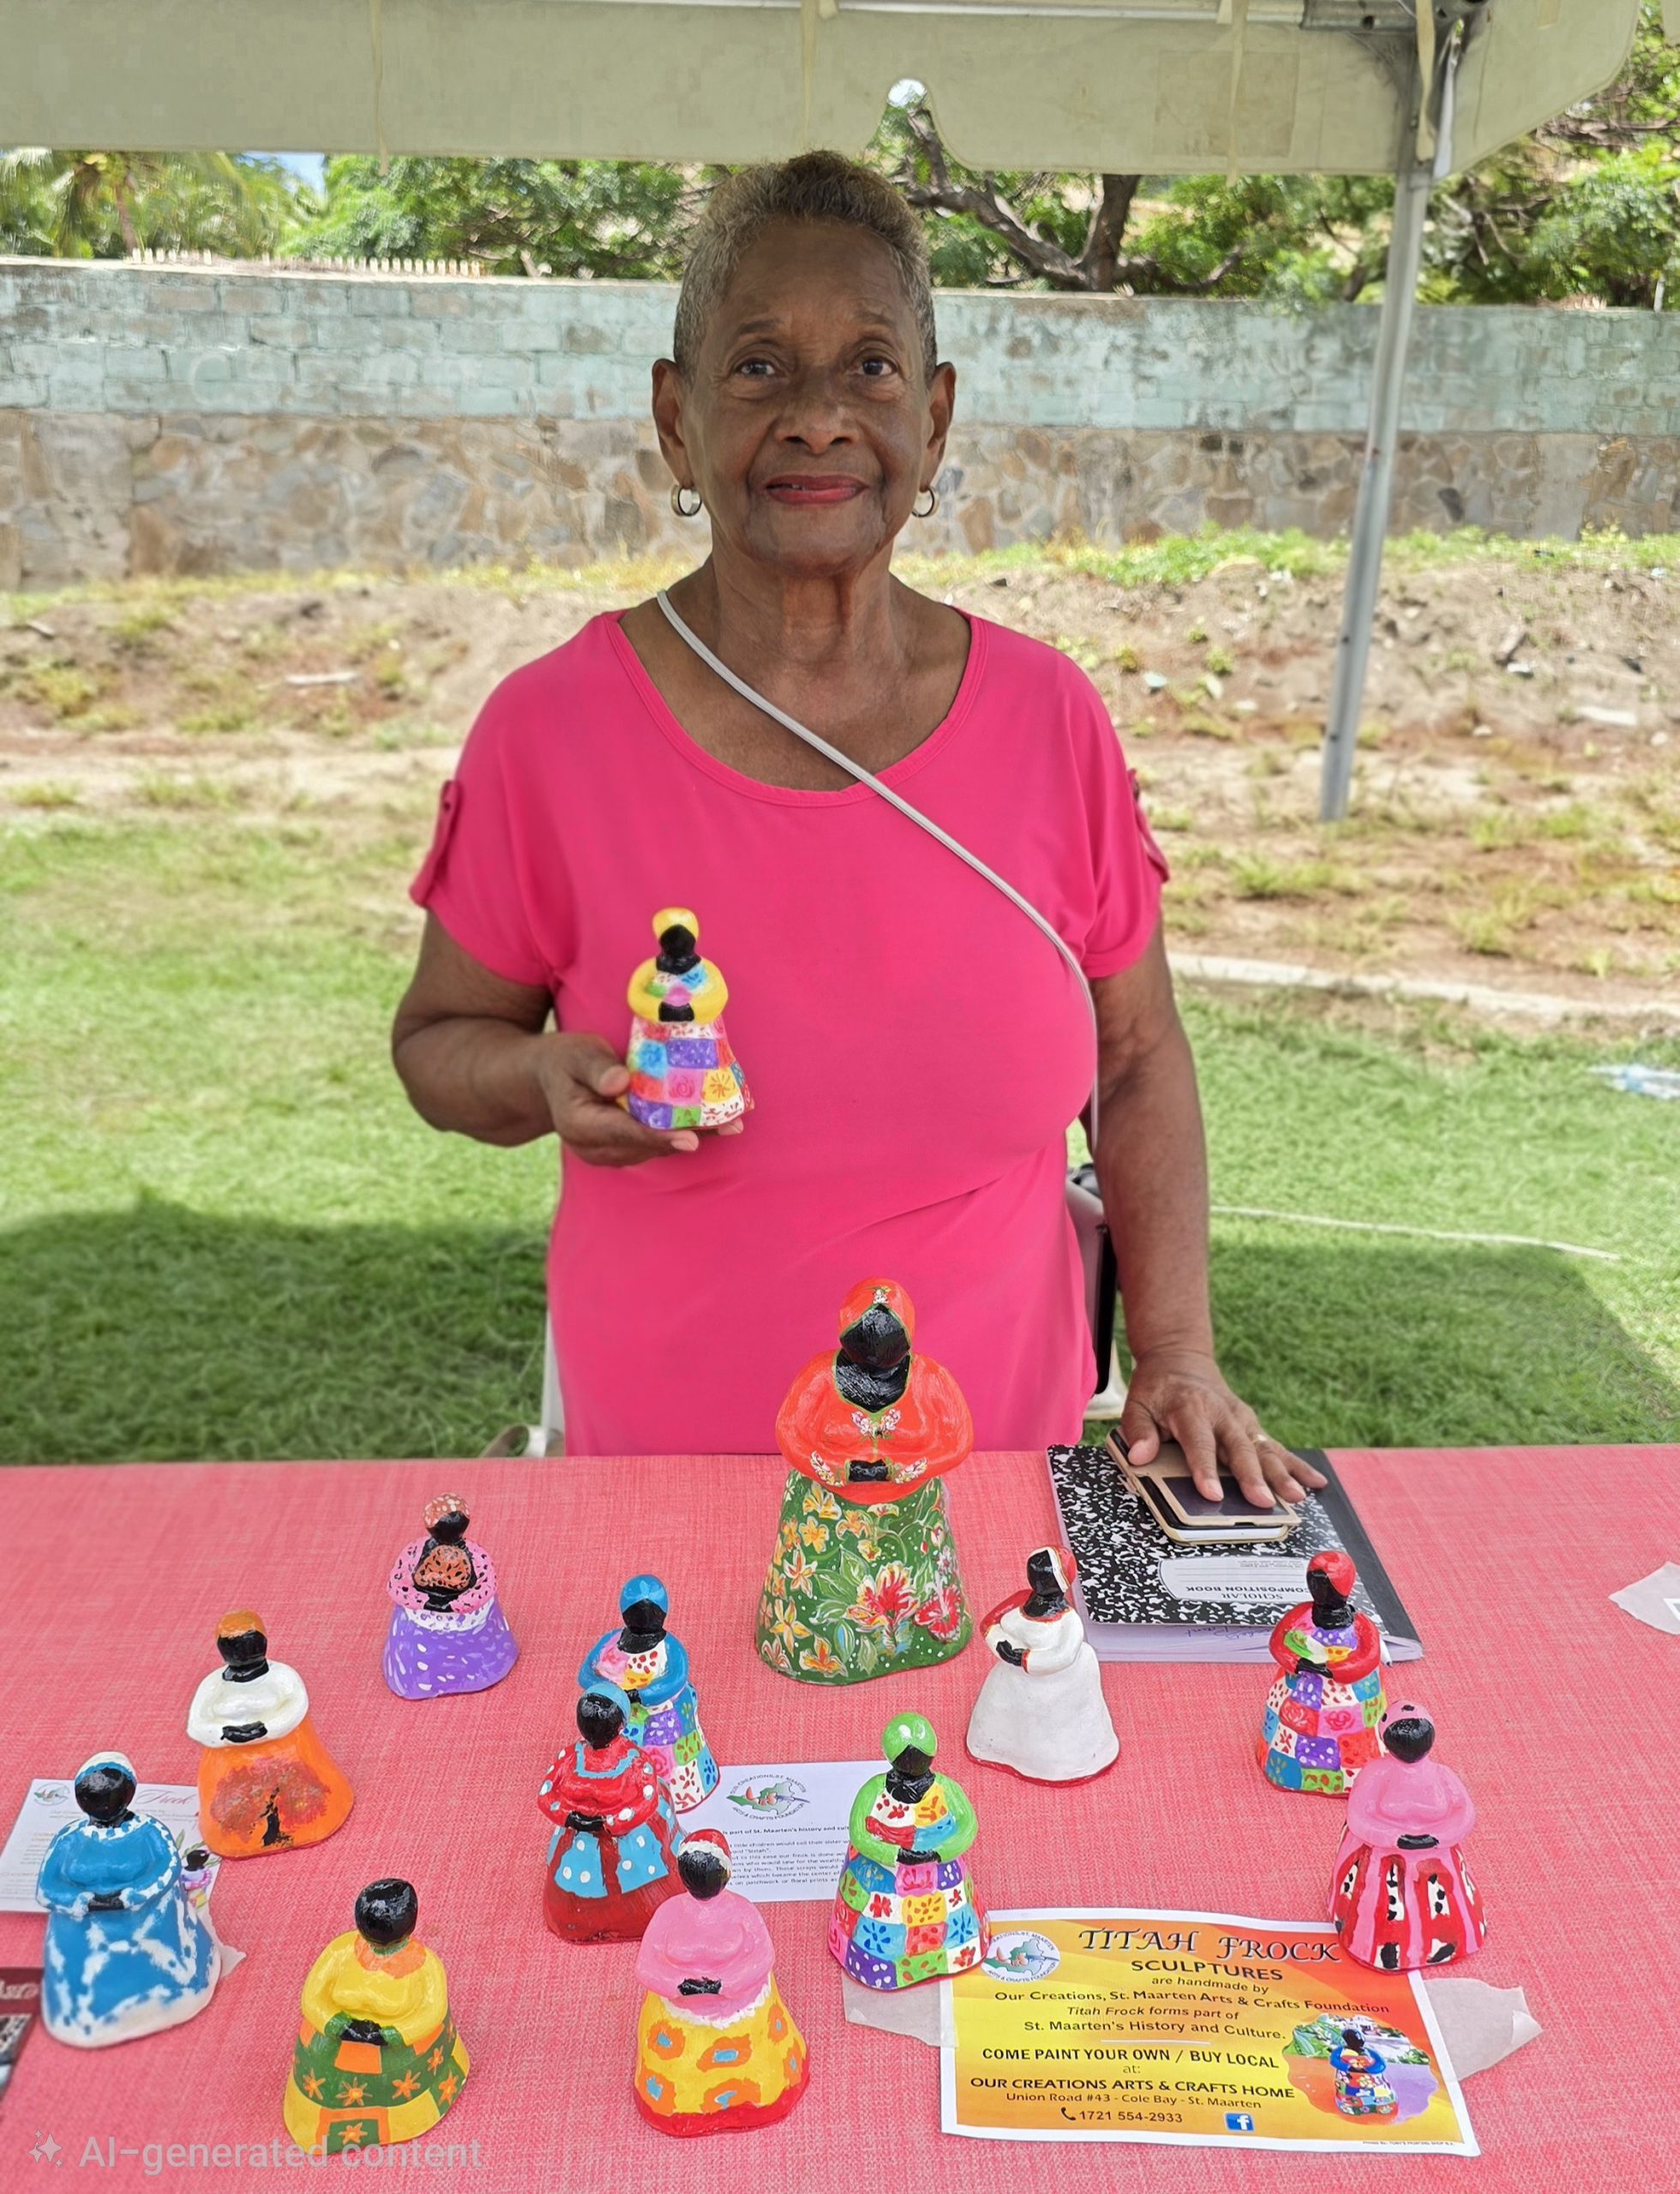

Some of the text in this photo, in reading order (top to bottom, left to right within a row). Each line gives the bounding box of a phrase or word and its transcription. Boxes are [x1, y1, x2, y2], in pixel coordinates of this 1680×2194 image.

[1078, 1927, 1341, 1963] TITAH FROCK
[1131, 1959, 1284, 1981] SCULPTURES
[1151, 1976, 1269, 1995] are handmade by
[994, 1990, 1390, 2014] Our Creations, St. Maarten Arts & Crafts Foundation
[1067, 2005, 1239, 2020] Titah Frock forms part of
[1023, 2020, 1287, 2040] St. Maarten's History and Culture.
[982, 2047, 1280, 2068] COME PAINT YOUR OWN / BUY LOCAL
[1122, 2065, 1141, 2074] at:
[970, 2077, 1295, 2098] OUR CREATIONS ARTS & CRAFTS HOME
[1006, 2092, 1045, 2101] Union
[1049, 2093, 1083, 2102] Road
[1087, 2094, 1111, 2102] #43
[1121, 2094, 1150, 2103] Cole
[1154, 2095, 1178, 2105] Bay
[1188, 2096, 1204, 2106] St.
[1208, 2098, 1262, 2109] Maarten
[1079, 2110, 1183, 2123] 1721 554-2933
